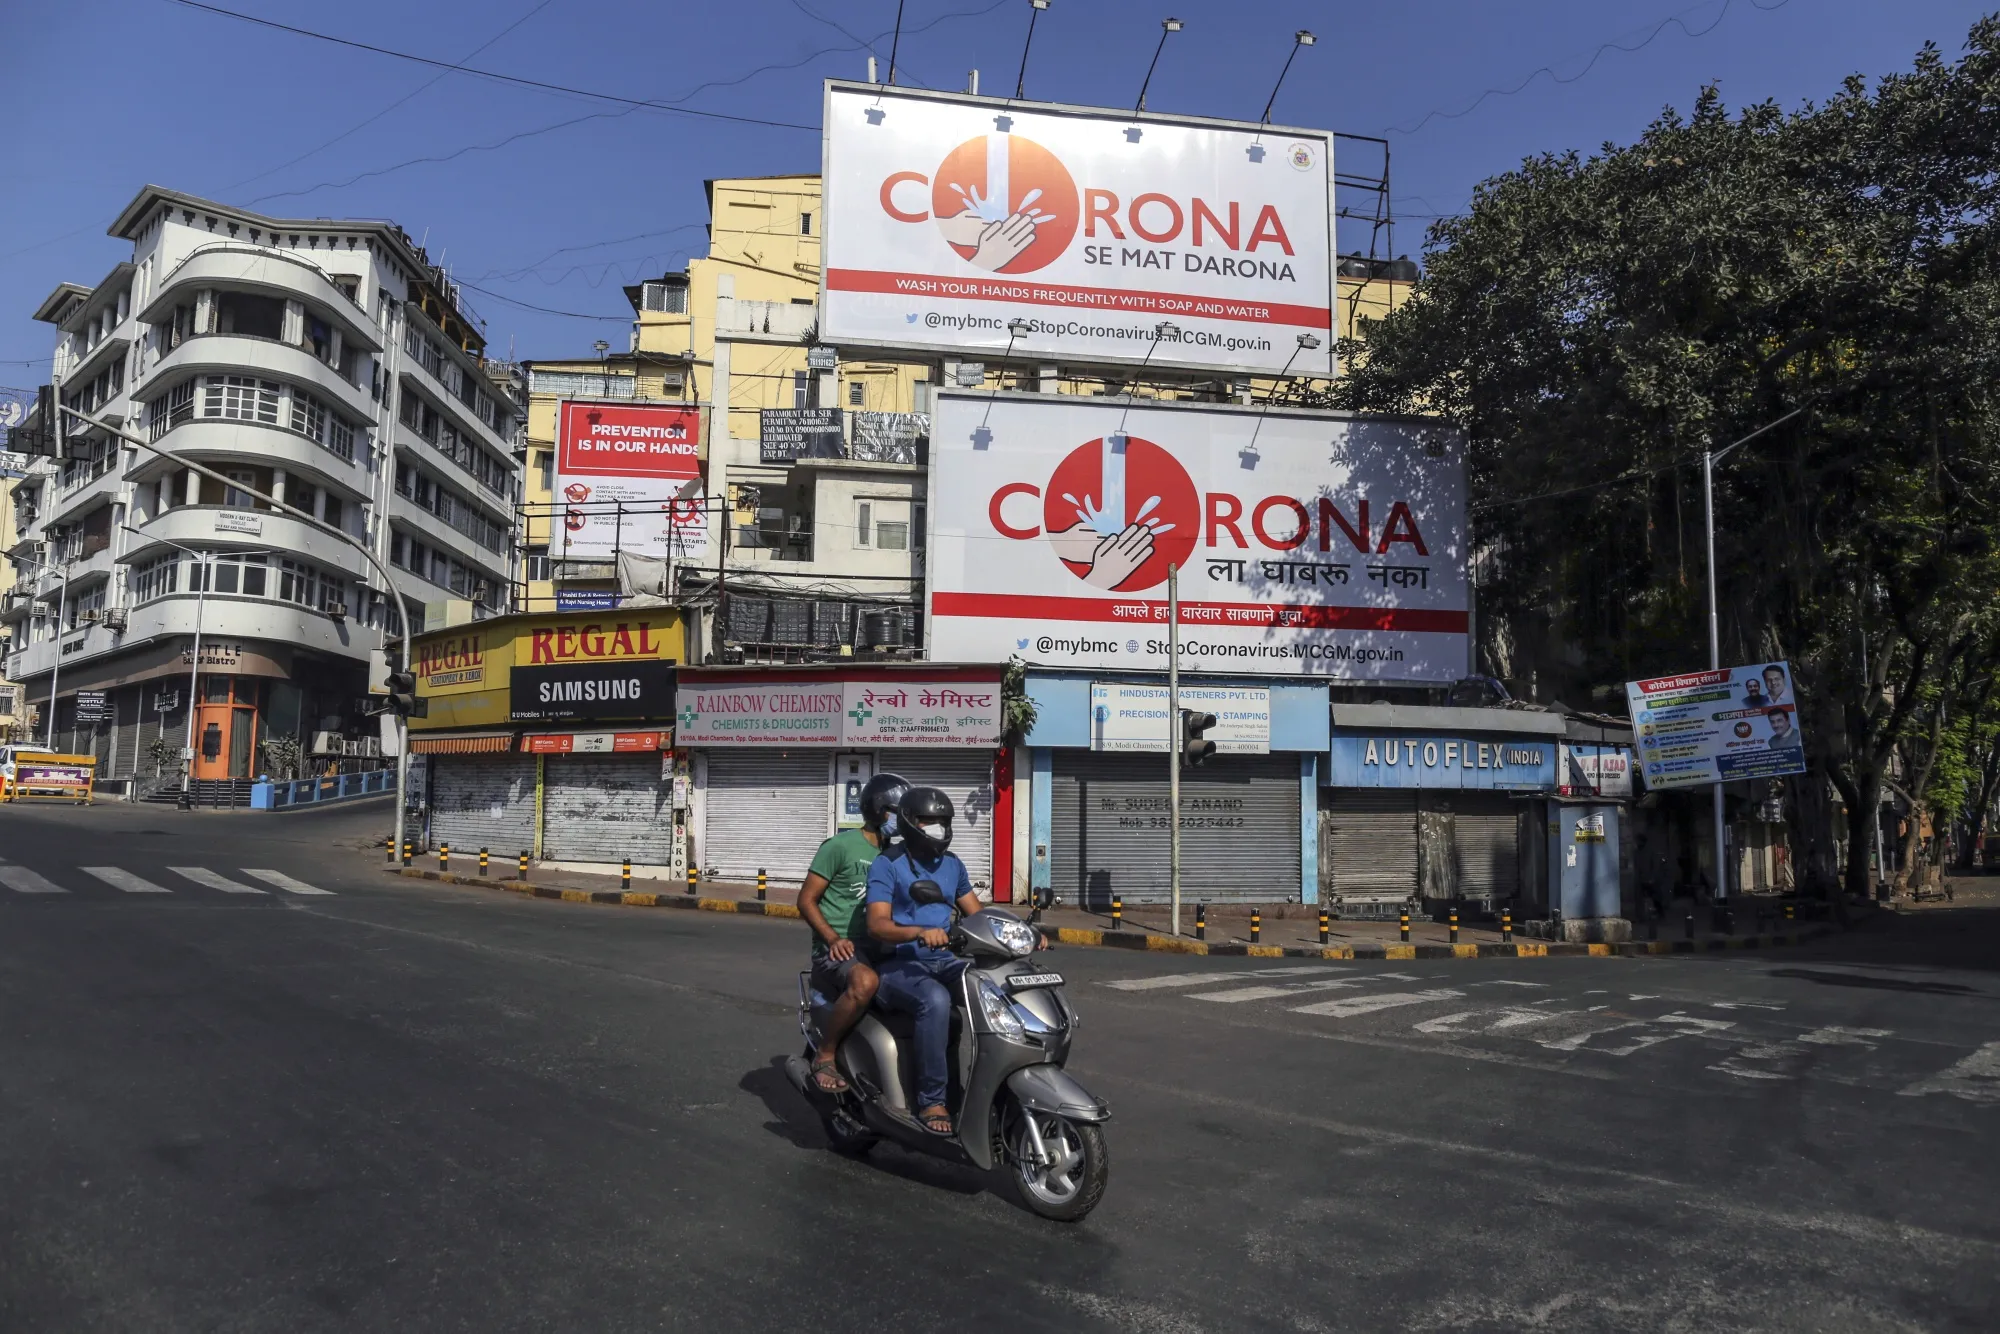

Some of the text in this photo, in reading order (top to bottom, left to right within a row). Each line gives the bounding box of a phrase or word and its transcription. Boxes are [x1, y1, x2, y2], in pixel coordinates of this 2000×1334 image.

[1084, 245, 1296, 283] SE MAT DARONA
[896, 278, 1270, 318] WASH YOUR HANDS FREQUENTLY WITH SOAP AND WATER
[925, 312, 1002, 330] @mybmc
[762, 410, 801, 418] PARAMOUNT
[591, 424, 687, 440] PREVENTION
[763, 434, 802, 442] ILLUMINATED
[578, 439, 699, 456] IS IN OUR HANDS
[763, 442, 777, 450] SIZE
[1205, 558, 1430, 590] ला घाबरू नका
[1112, 601, 1149, 618] आपले
[1182, 603, 1221, 620] वारंवार
[1226, 605, 1275, 622] साबणाने
[531, 622, 660, 664] REGAL
[1036, 636, 1118, 655] @mybmc
[206, 656, 236, 666] Bistro
[419, 636, 484, 678] REGAL
[540, 678, 641, 702] SAMSUNG
[918, 688, 992, 708] केमिस्ट
[1119, 689, 1268, 700] HINDUSTAN ASTENERS PVT. LTD.
[697, 693, 842, 713] RAINBOW CHEMISTS
[877, 715, 913, 725] केमिस्ट
[921, 715, 948, 725] आणि
[1119, 709, 1169, 718] PRECISION
[1223, 711, 1268, 721] STAMPING
[712, 718, 830, 730] CHEMISTS & DRUGGISTS
[1133, 742, 1164, 750] Chambers,
[1364, 739, 1545, 769] AUTOFLEX (INDIA)
[1603, 758, 1626, 772] AZAD
[1191, 799, 1243, 811] ANAND
[1119, 817, 1143, 827] Mob
